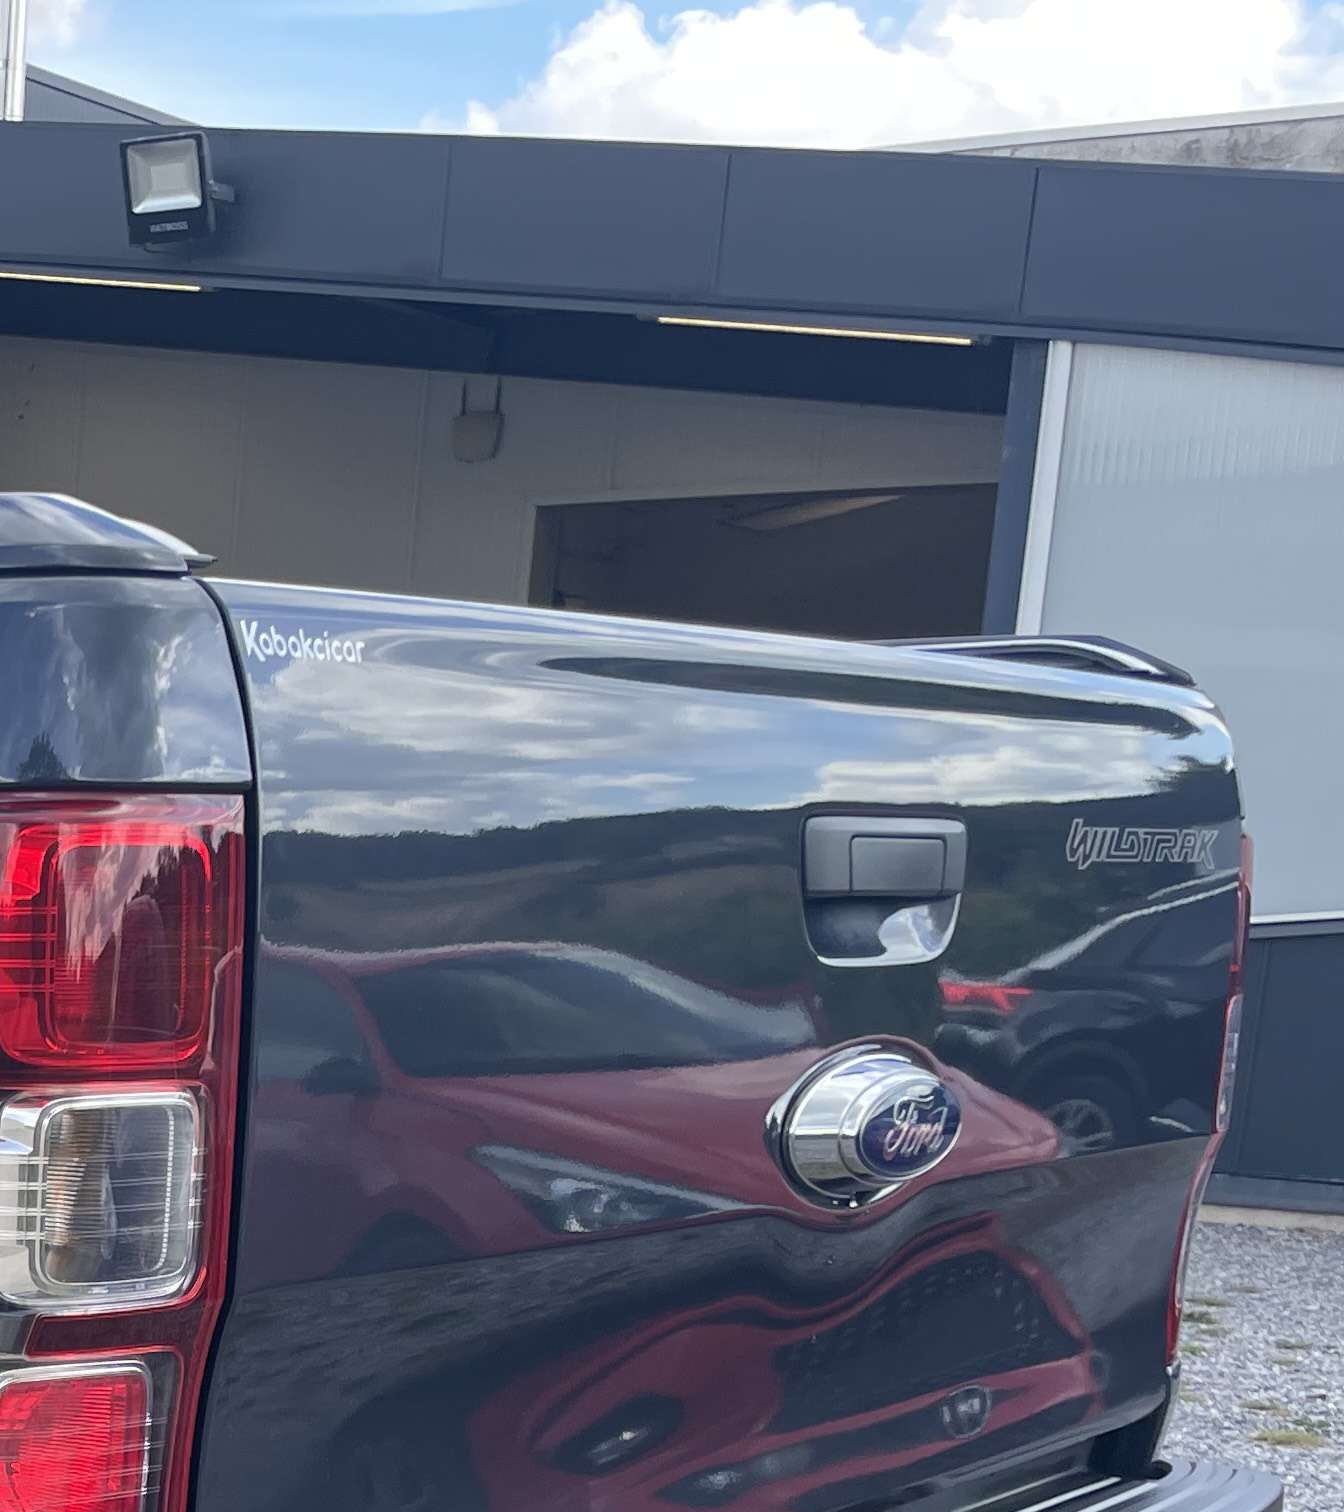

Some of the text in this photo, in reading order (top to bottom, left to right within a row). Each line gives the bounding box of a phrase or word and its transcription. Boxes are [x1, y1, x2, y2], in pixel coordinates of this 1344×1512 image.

[240, 619, 365, 663] Kabakcicar
[1066, 818, 1219, 870] WILDTRAK
[885, 1095, 948, 1160] Ford
